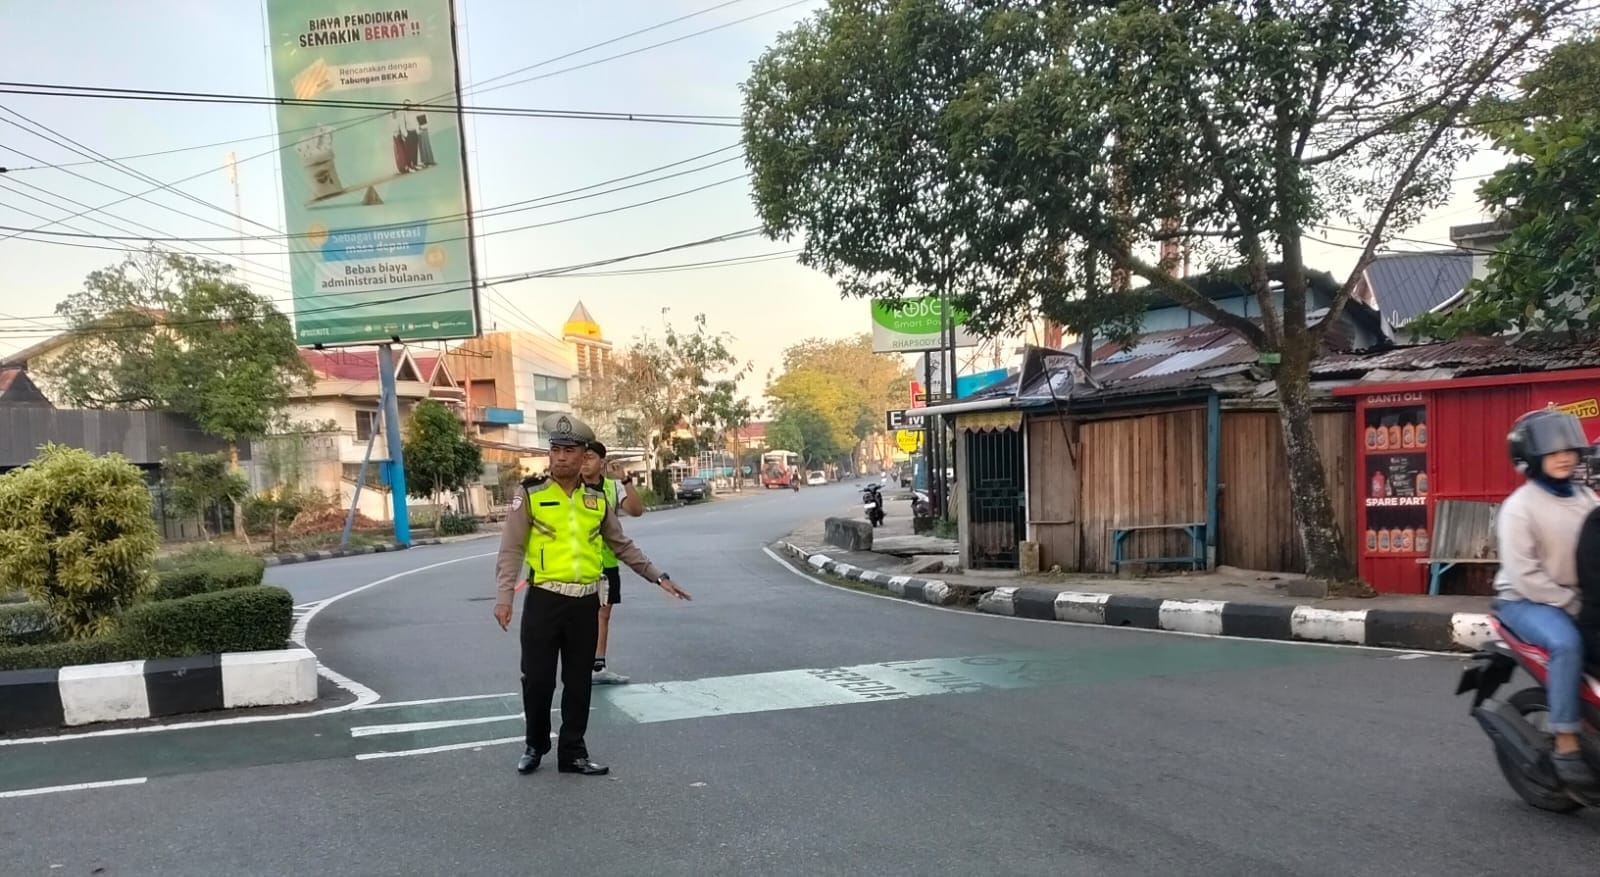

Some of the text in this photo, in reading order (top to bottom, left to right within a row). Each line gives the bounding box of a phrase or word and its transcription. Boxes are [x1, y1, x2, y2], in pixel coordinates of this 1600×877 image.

[309, 10, 409, 31] BIAYA PENDIDIKAN
[299, 29, 361, 48] SEMAKIN
[364, 23, 407, 41] BERAT
[339, 61, 418, 76] Rencanakan dengan
[340, 72, 409, 86] Tabungan BEKAL
[345, 262, 408, 276] Bebas biaya
[321, 272, 434, 289] administrasi bulanan
[1367, 392, 1422, 403] GANTI OLI
[1570, 406, 1598, 417] UTO
[1366, 496, 1427, 507] SPARE PART
